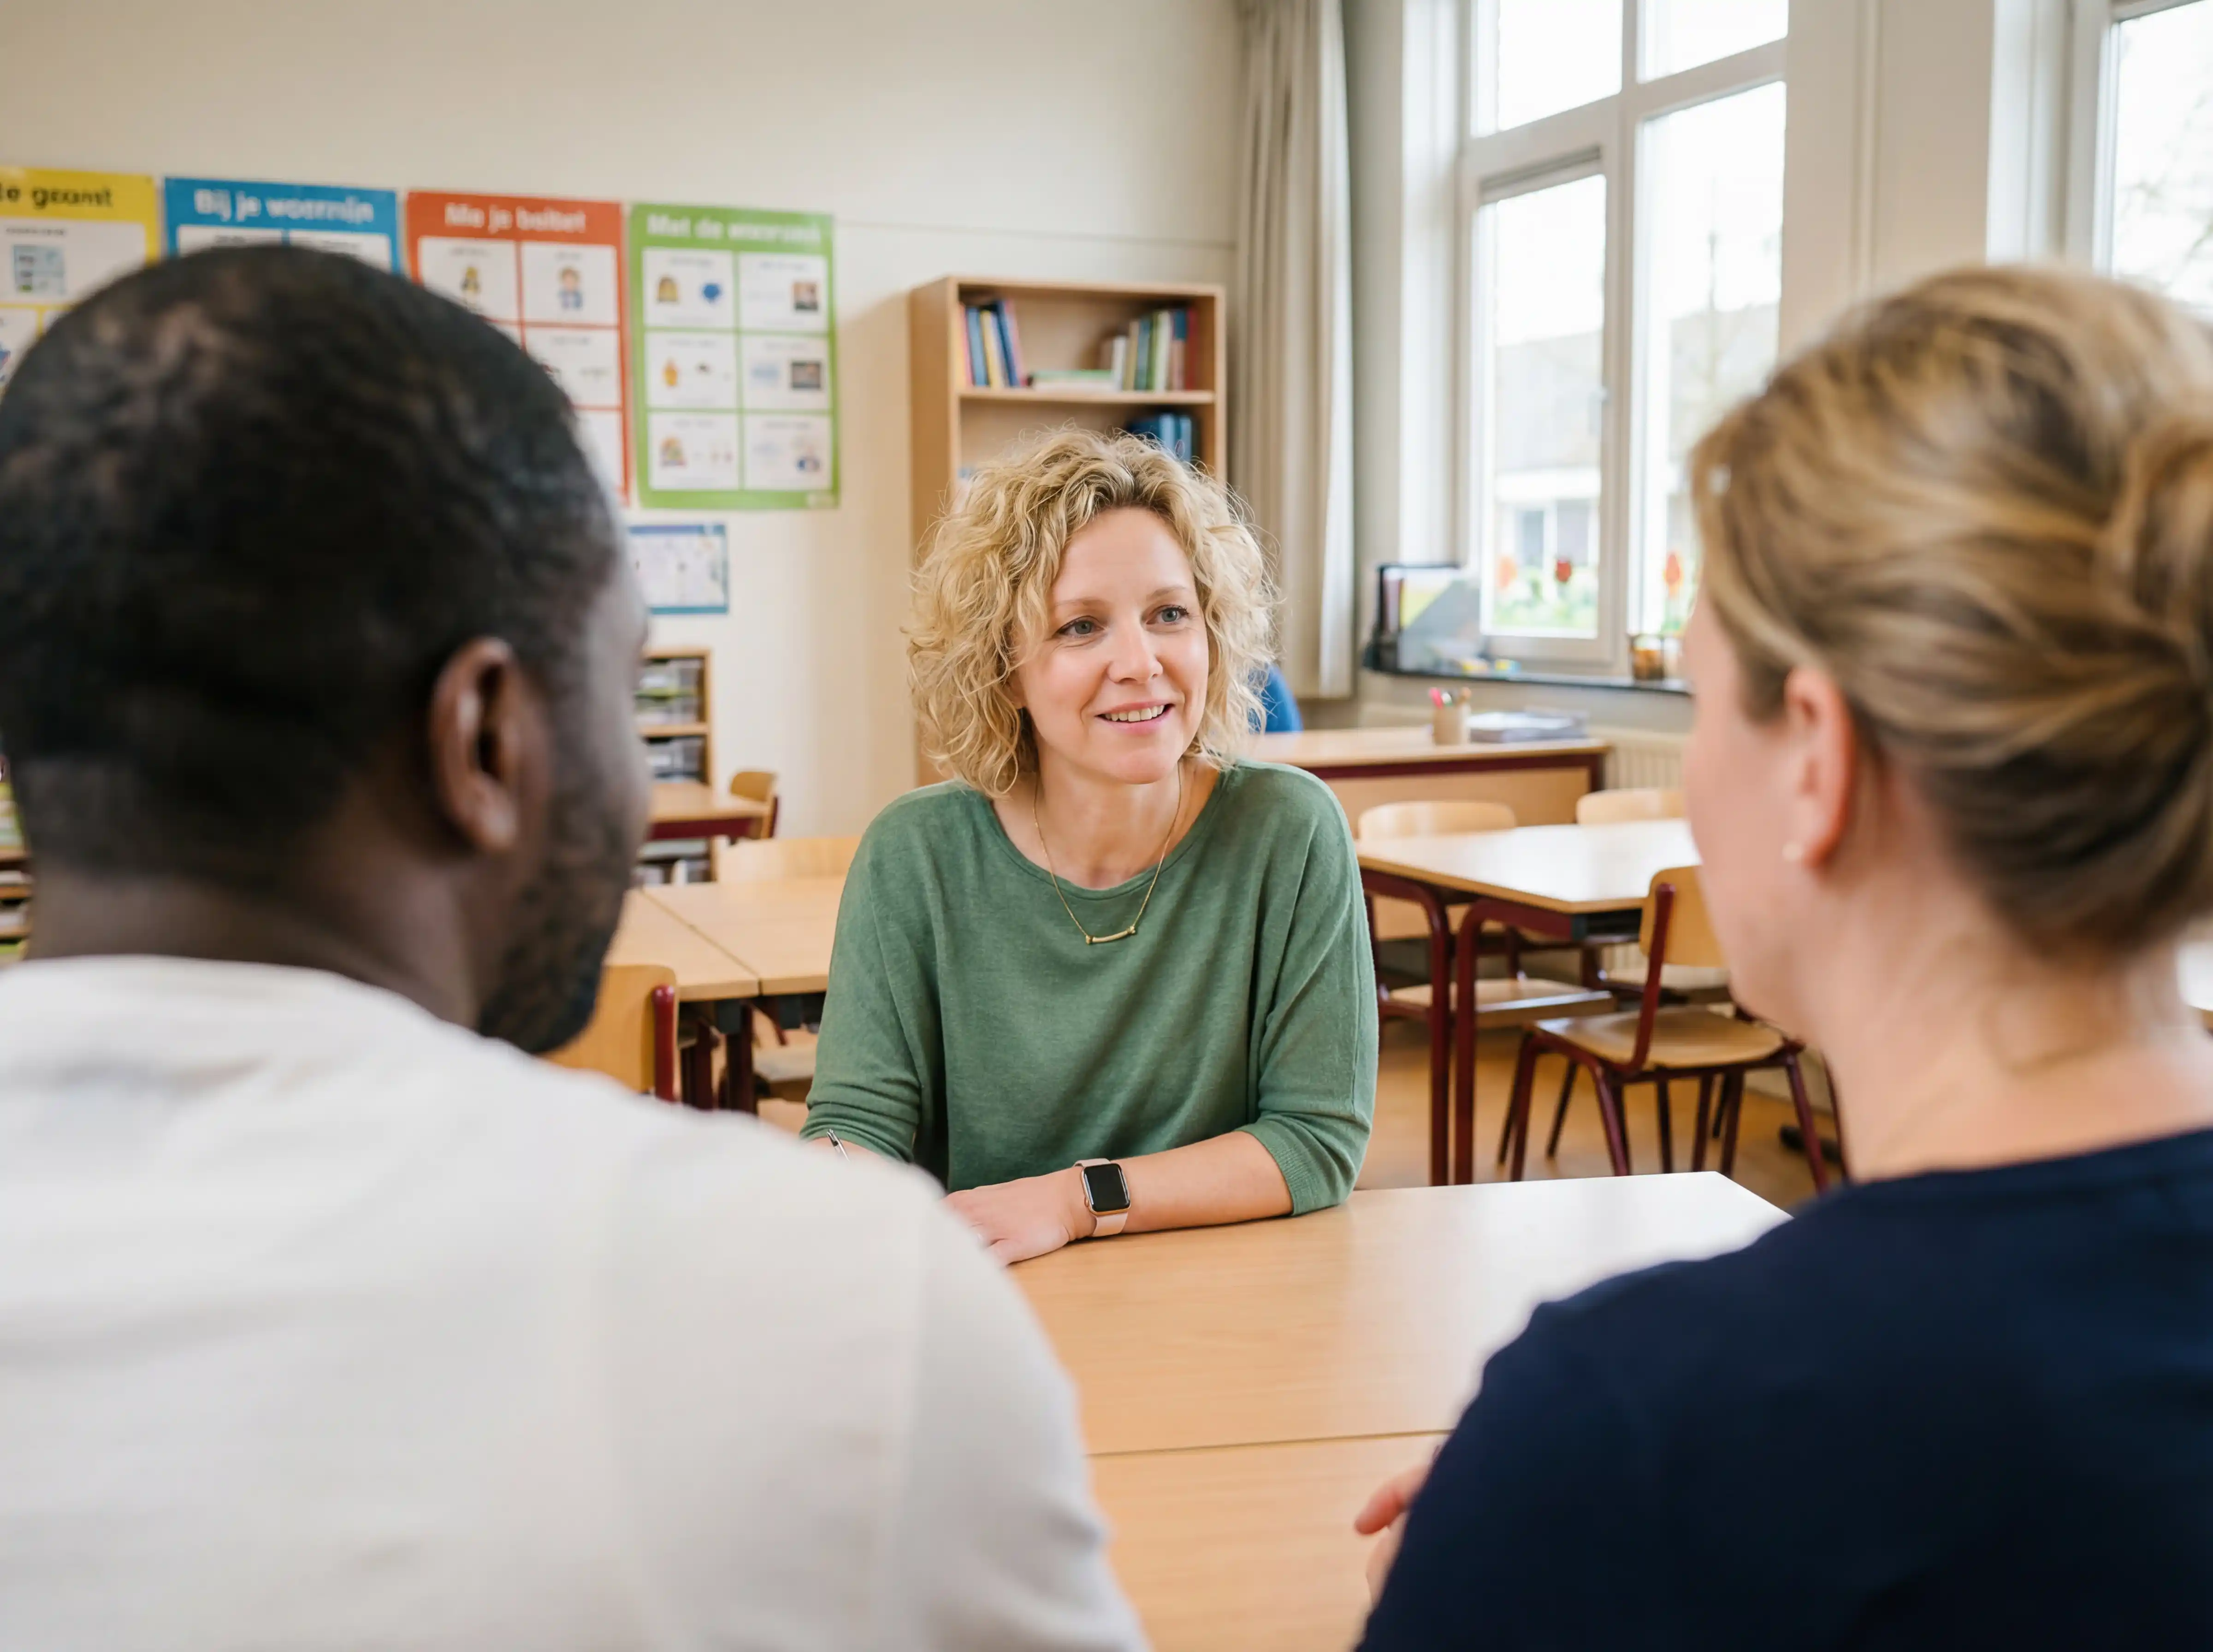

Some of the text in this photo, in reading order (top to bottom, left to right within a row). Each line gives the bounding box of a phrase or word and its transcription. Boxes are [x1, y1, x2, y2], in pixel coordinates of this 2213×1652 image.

[194, 189, 231, 222] Bij
[236, 190, 261, 222] je
[488, 205, 510, 234] je
